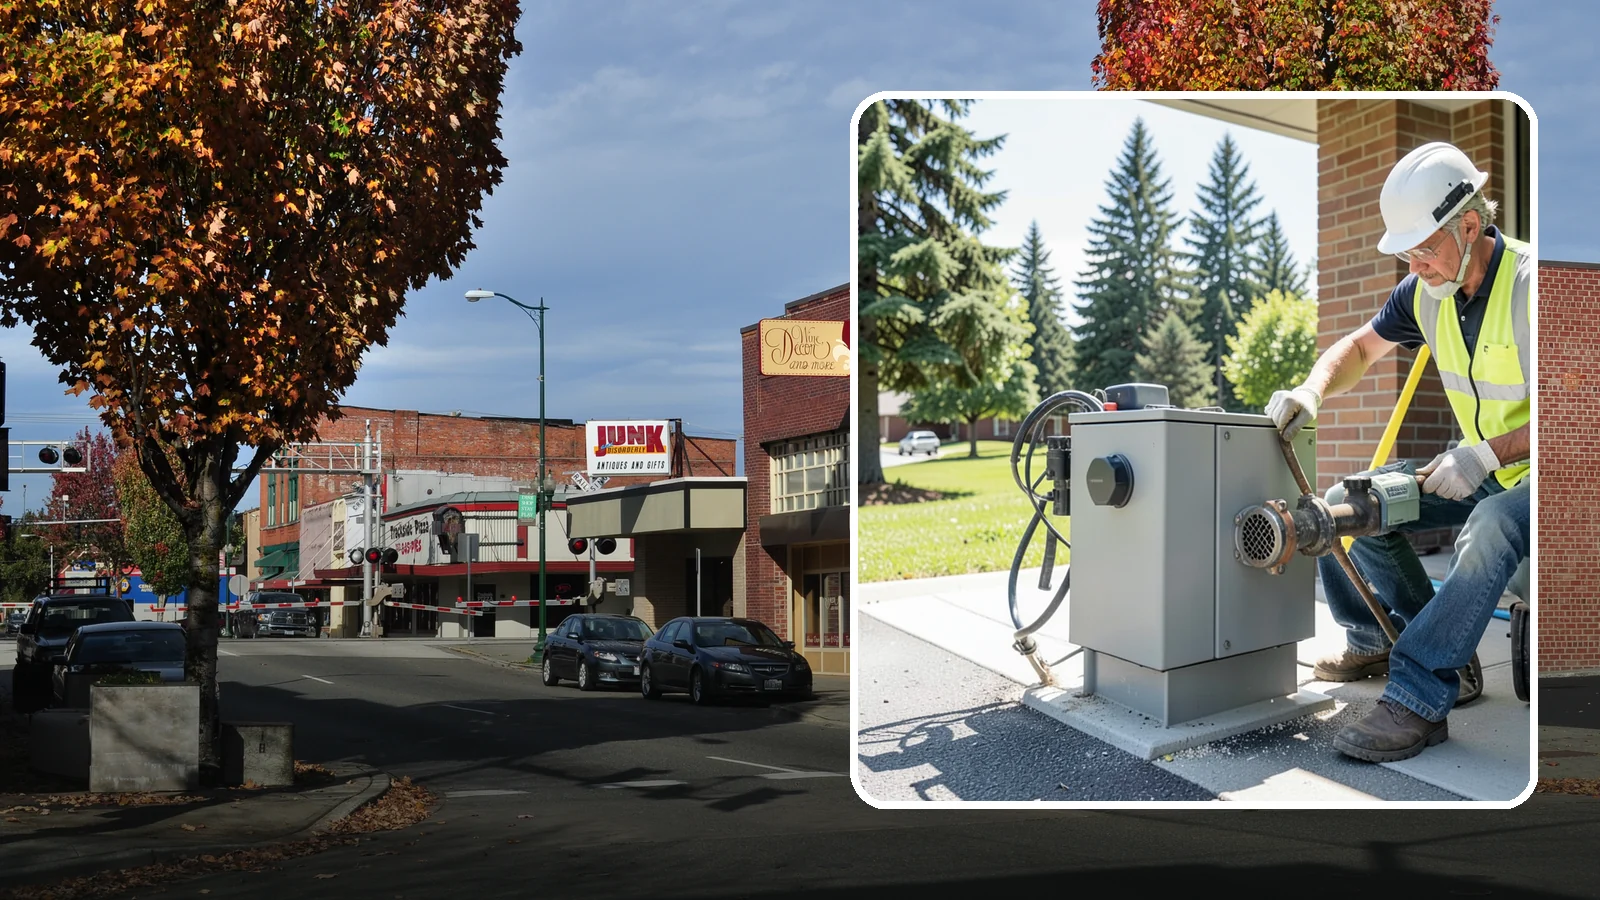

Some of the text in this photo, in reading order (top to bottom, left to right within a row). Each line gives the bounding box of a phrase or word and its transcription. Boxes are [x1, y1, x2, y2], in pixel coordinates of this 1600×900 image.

[595, 425, 665, 457] JUNK
[607, 446, 645, 454] DISORDERLY
[597, 461, 665, 469] ANTIQUES AND GIFTS
[390, 519, 429, 539] Trackside Pizza
